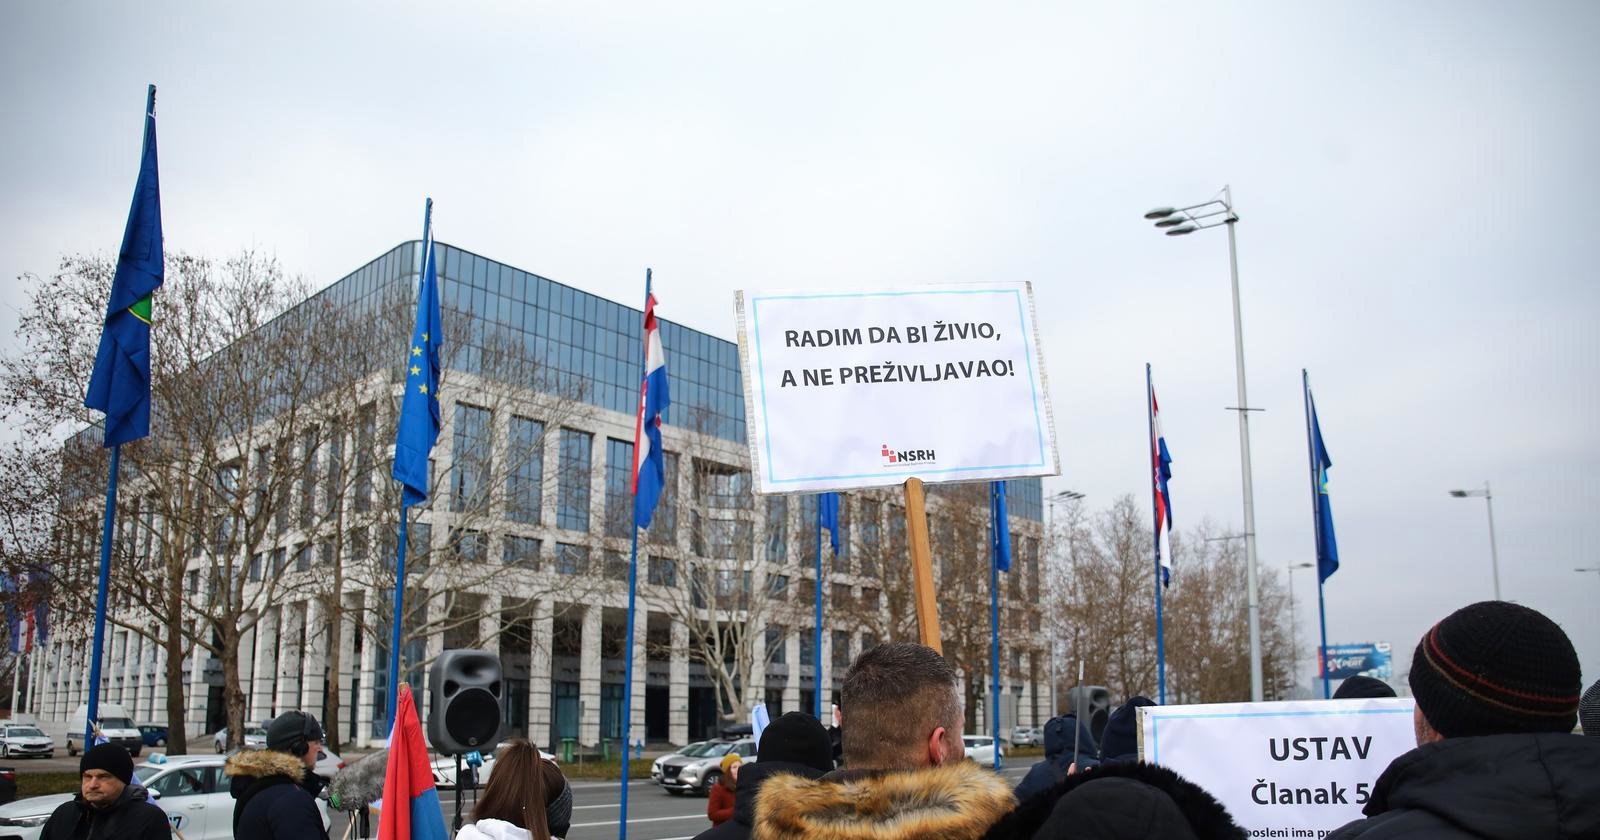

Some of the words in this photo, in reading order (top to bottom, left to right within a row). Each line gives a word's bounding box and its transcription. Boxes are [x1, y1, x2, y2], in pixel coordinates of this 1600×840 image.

[785, 328, 863, 348] RADIM
[868, 326, 902, 344] DA
[906, 325, 928, 344] BI
[933, 320, 1001, 342] ŽIVIO,
[780, 369, 798, 388] A
[802, 368, 834, 387] NE
[839, 359, 1015, 385] PREŽIVLJAVAO!
[897, 449, 936, 463] NSRH
[1269, 735, 1373, 762] USTAV
[1251, 778, 1349, 806] Članak
[1291, 827, 1314, 838] ima
[1317, 829, 1333, 840] pr
